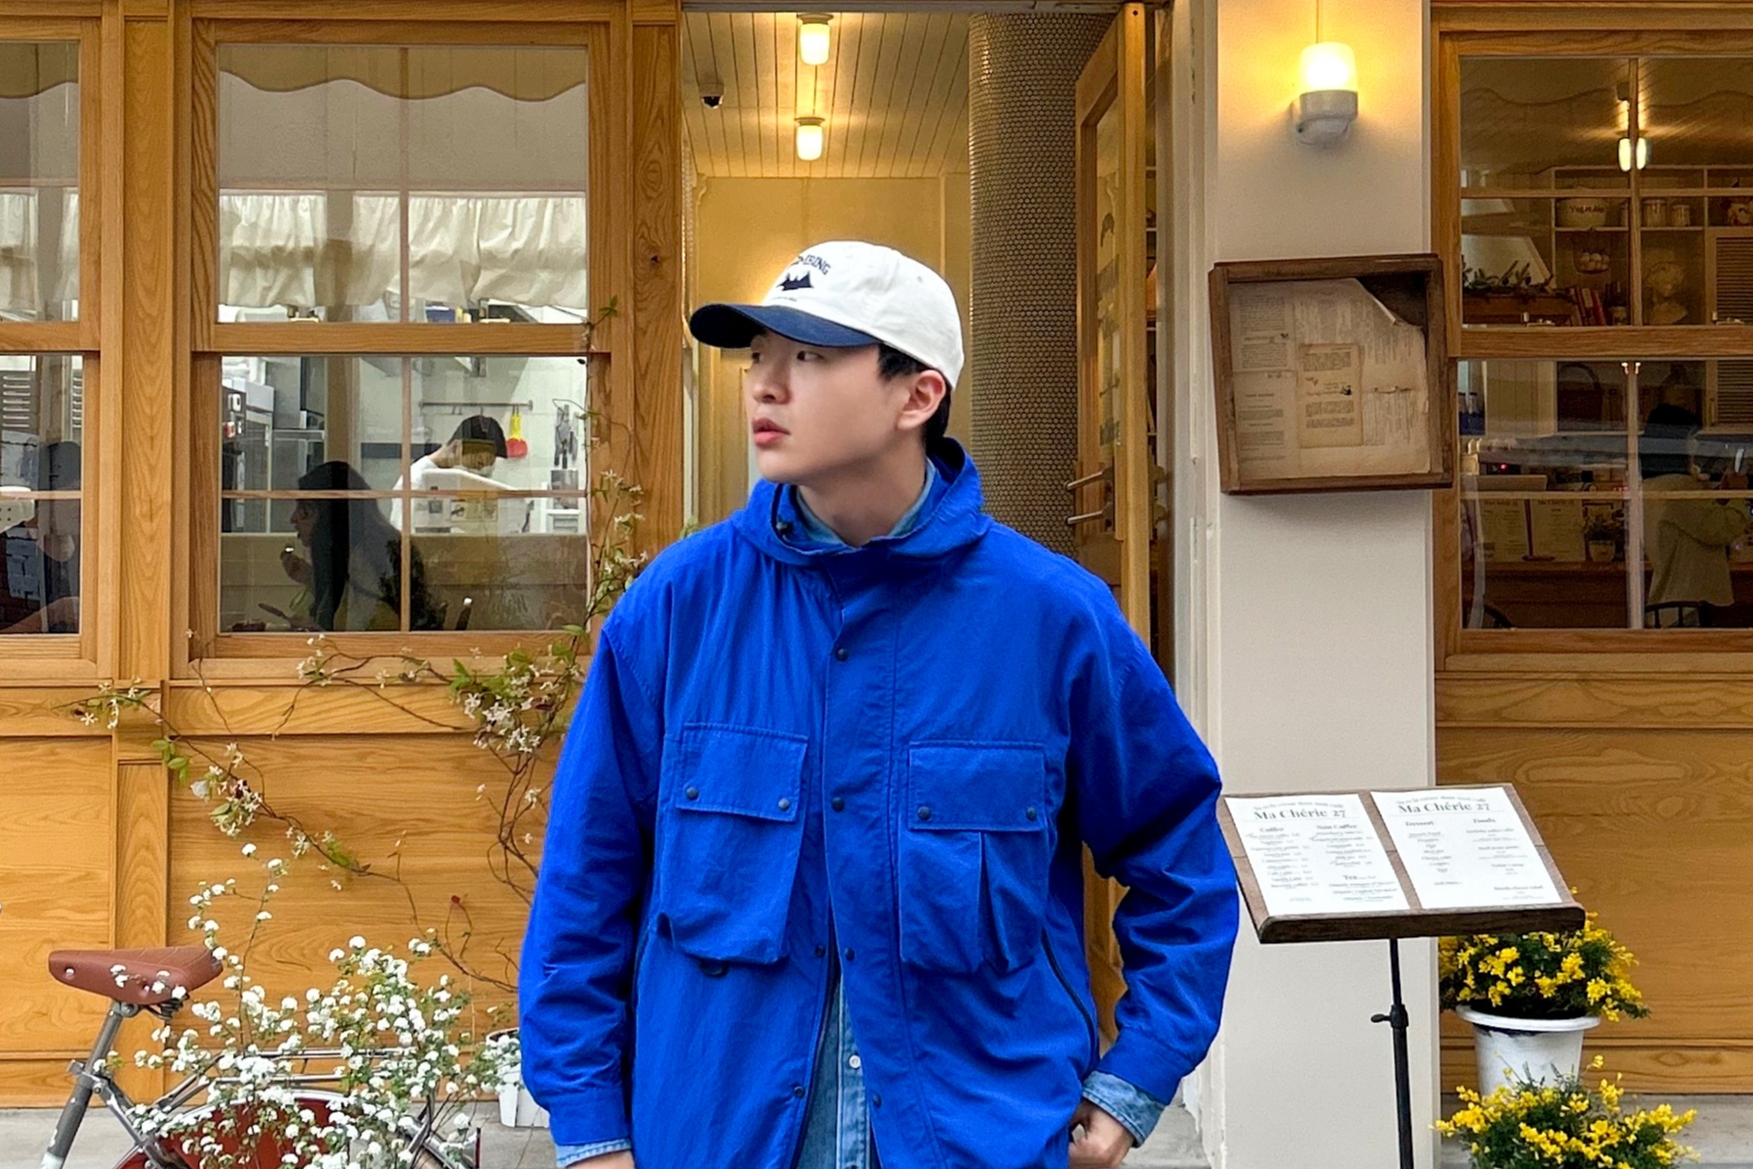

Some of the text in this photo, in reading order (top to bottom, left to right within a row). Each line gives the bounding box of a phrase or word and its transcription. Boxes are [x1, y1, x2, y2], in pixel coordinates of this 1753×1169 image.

[1398, 801, 1490, 814] Ma Chérie 27
[1254, 808, 1346, 820] Ma Chérie 27
